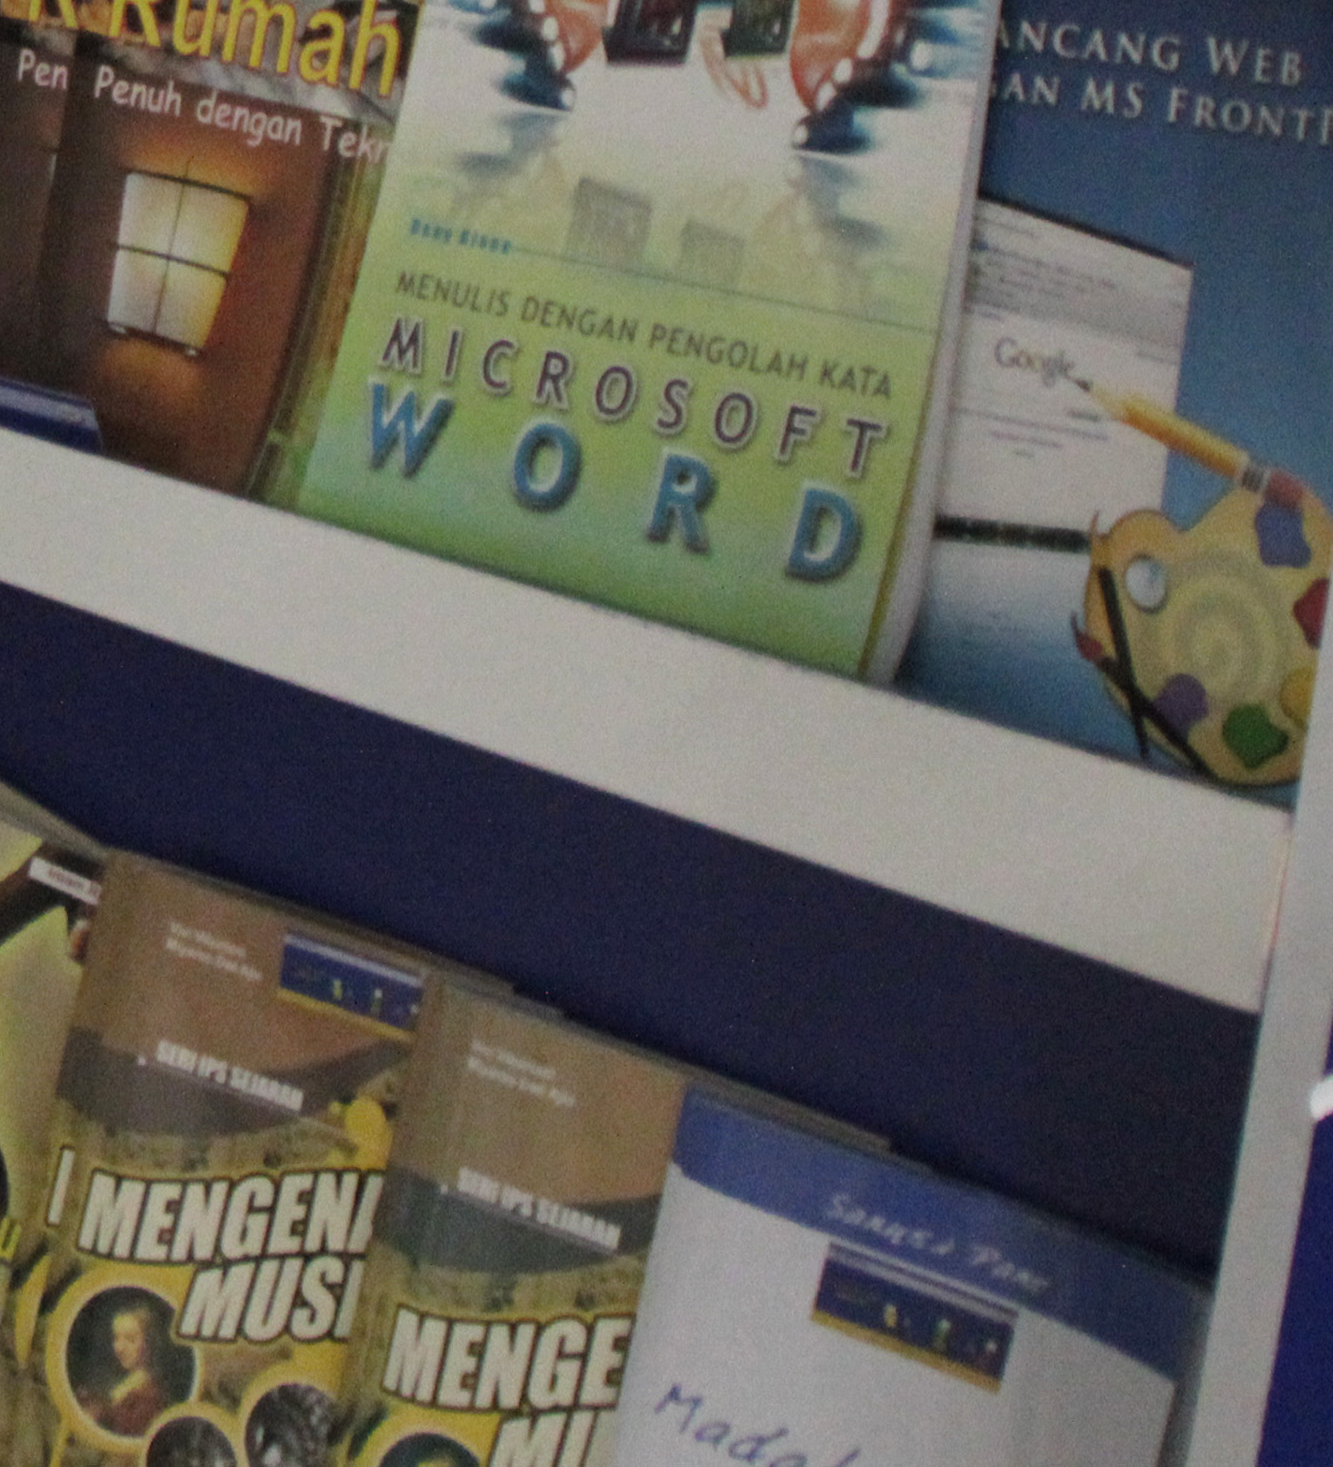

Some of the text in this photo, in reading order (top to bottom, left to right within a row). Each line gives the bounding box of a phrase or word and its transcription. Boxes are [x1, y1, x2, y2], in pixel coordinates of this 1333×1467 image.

[17, 48, 70, 92] Pen
[1206, 34, 1303, 86] WEB
[94, 66, 183, 119] Penuh
[195, 84, 305, 150] dengan
[1083, 75, 1145, 120] MS
[395, 270, 894, 400] MENULIS DENGAN PENGOLAH KATA
[992, 337, 1077, 390] Google
[378, 315, 891, 480] MICROSOFT
[367, 383, 865, 586] WORD
